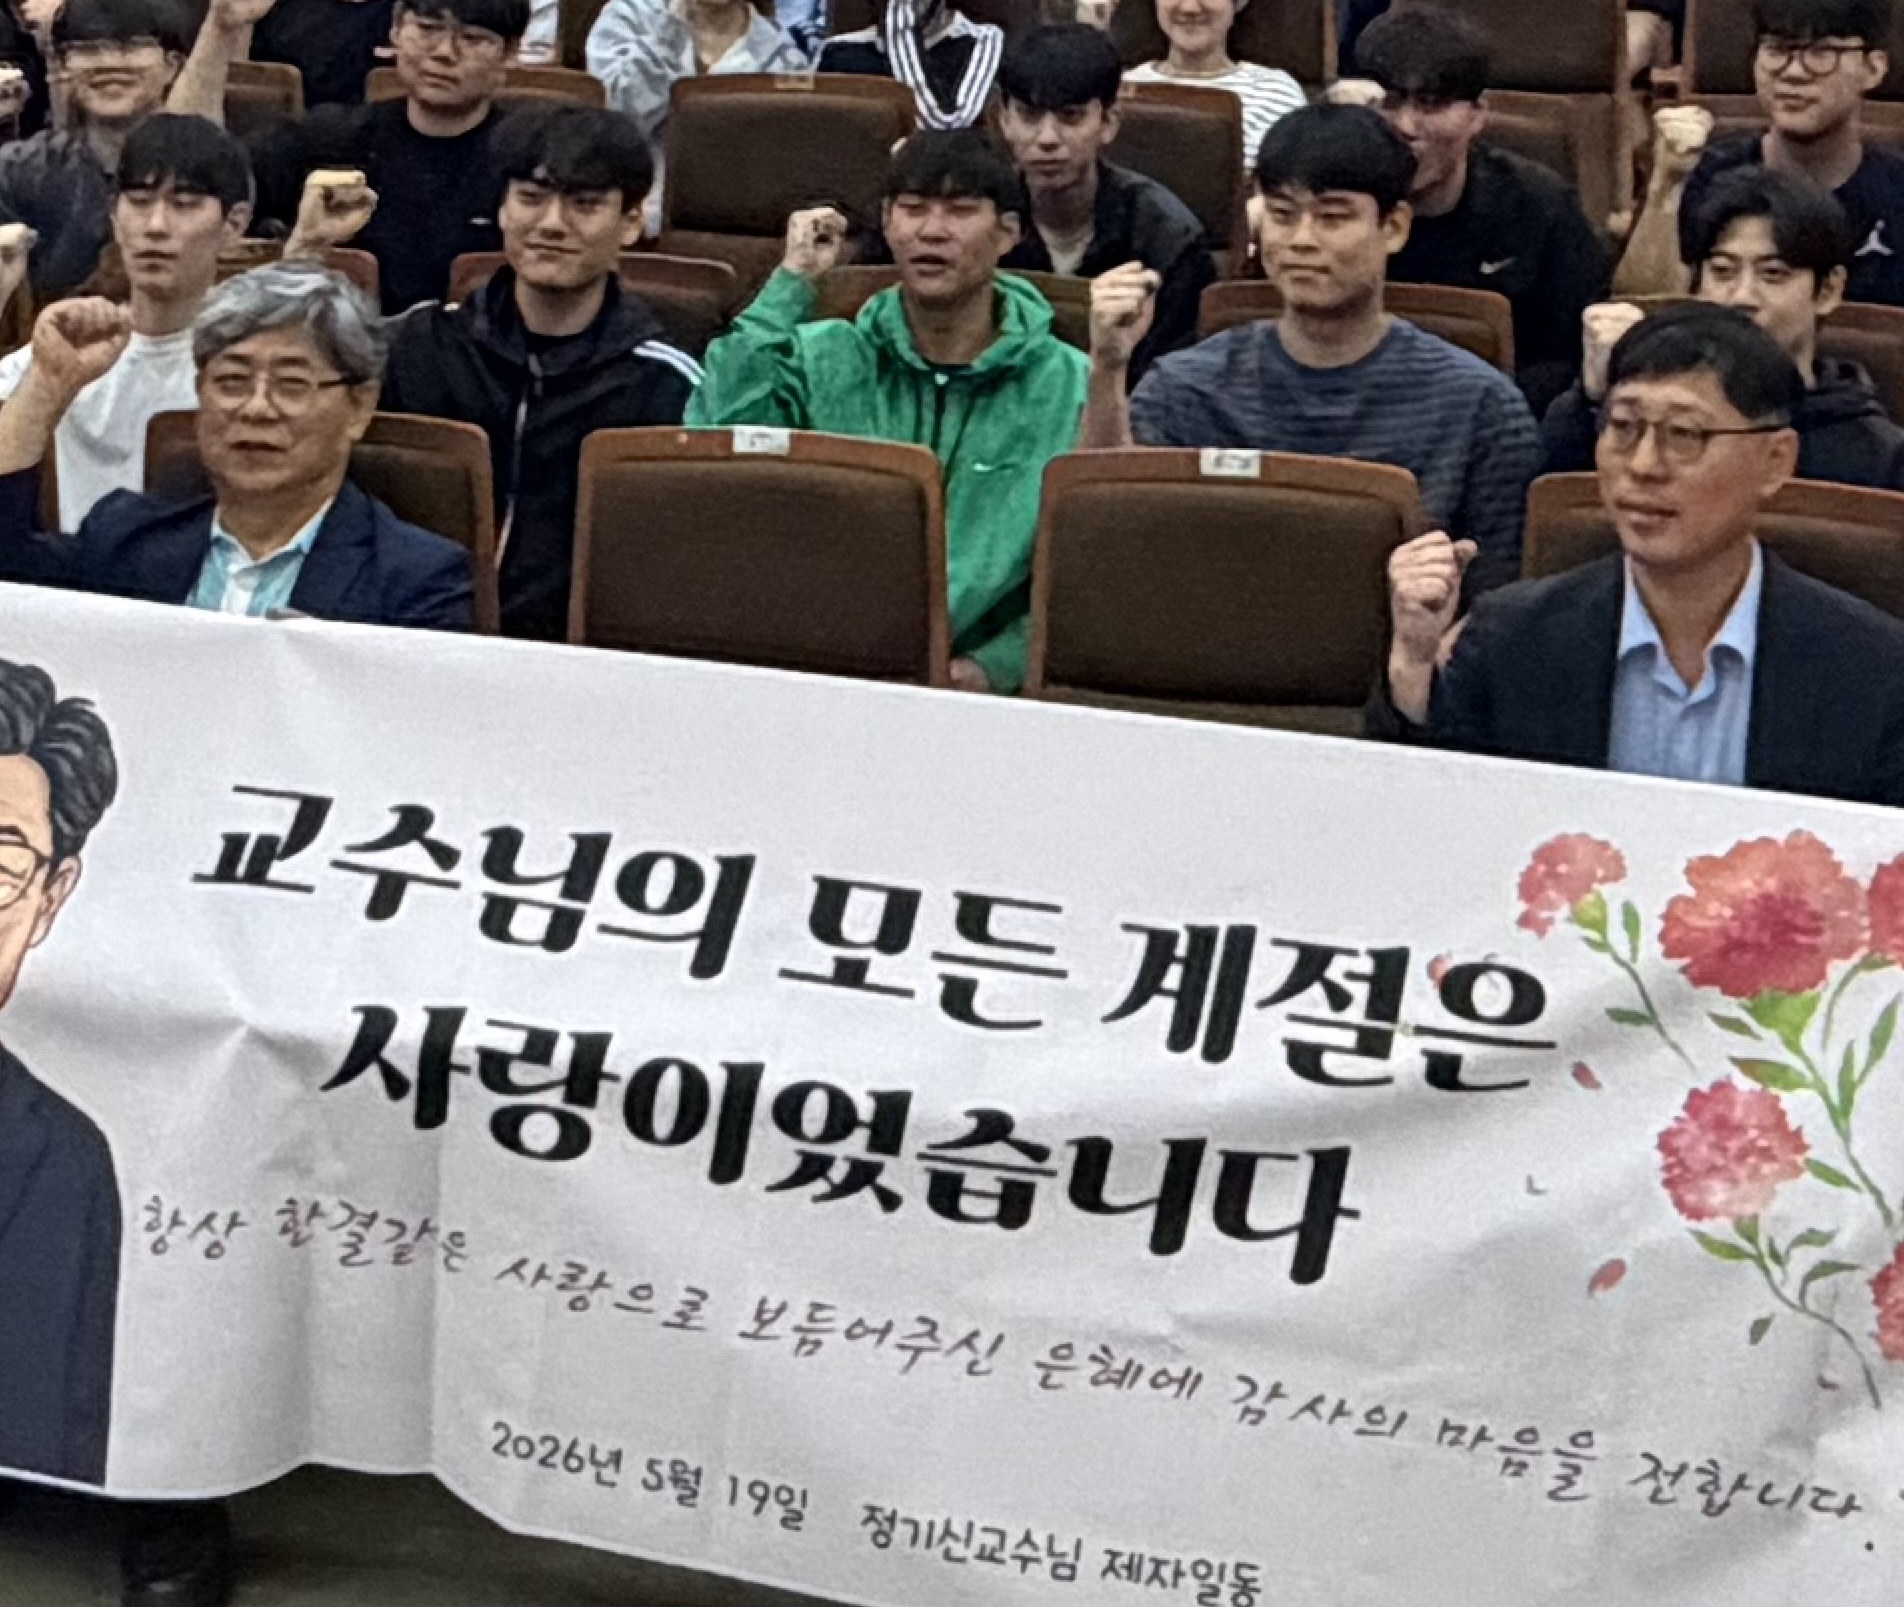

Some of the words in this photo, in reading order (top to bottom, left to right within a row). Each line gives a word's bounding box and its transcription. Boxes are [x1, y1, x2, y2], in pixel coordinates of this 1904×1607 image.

[193, 786, 755, 980] 교수님의
[779, 876, 1067, 1030] 모든
[1101, 921, 1557, 1092] 계절은
[319, 1005, 1361, 1286] 사랑이었습니다
[144, 1196, 248, 1260] 항상
[275, 1198, 468, 1272] 한결같은
[494, 1258, 709, 1332] 사랑으로
[738, 1296, 1005, 1376] 보듬어주신
[1034, 1341, 1203, 1400] 은혜에
[1232, 1374, 1408, 1438] 감사의
[1437, 1415, 1597, 1502] 마음을
[493, 1422, 623, 1488] 2026년
[641, 1458, 703, 1508] 5월
[729, 1476, 807, 1532] 19일
[861, 1504, 1081, 1582] 정기신교수님
[1101, 1549, 1261, 1607] 제자일동
